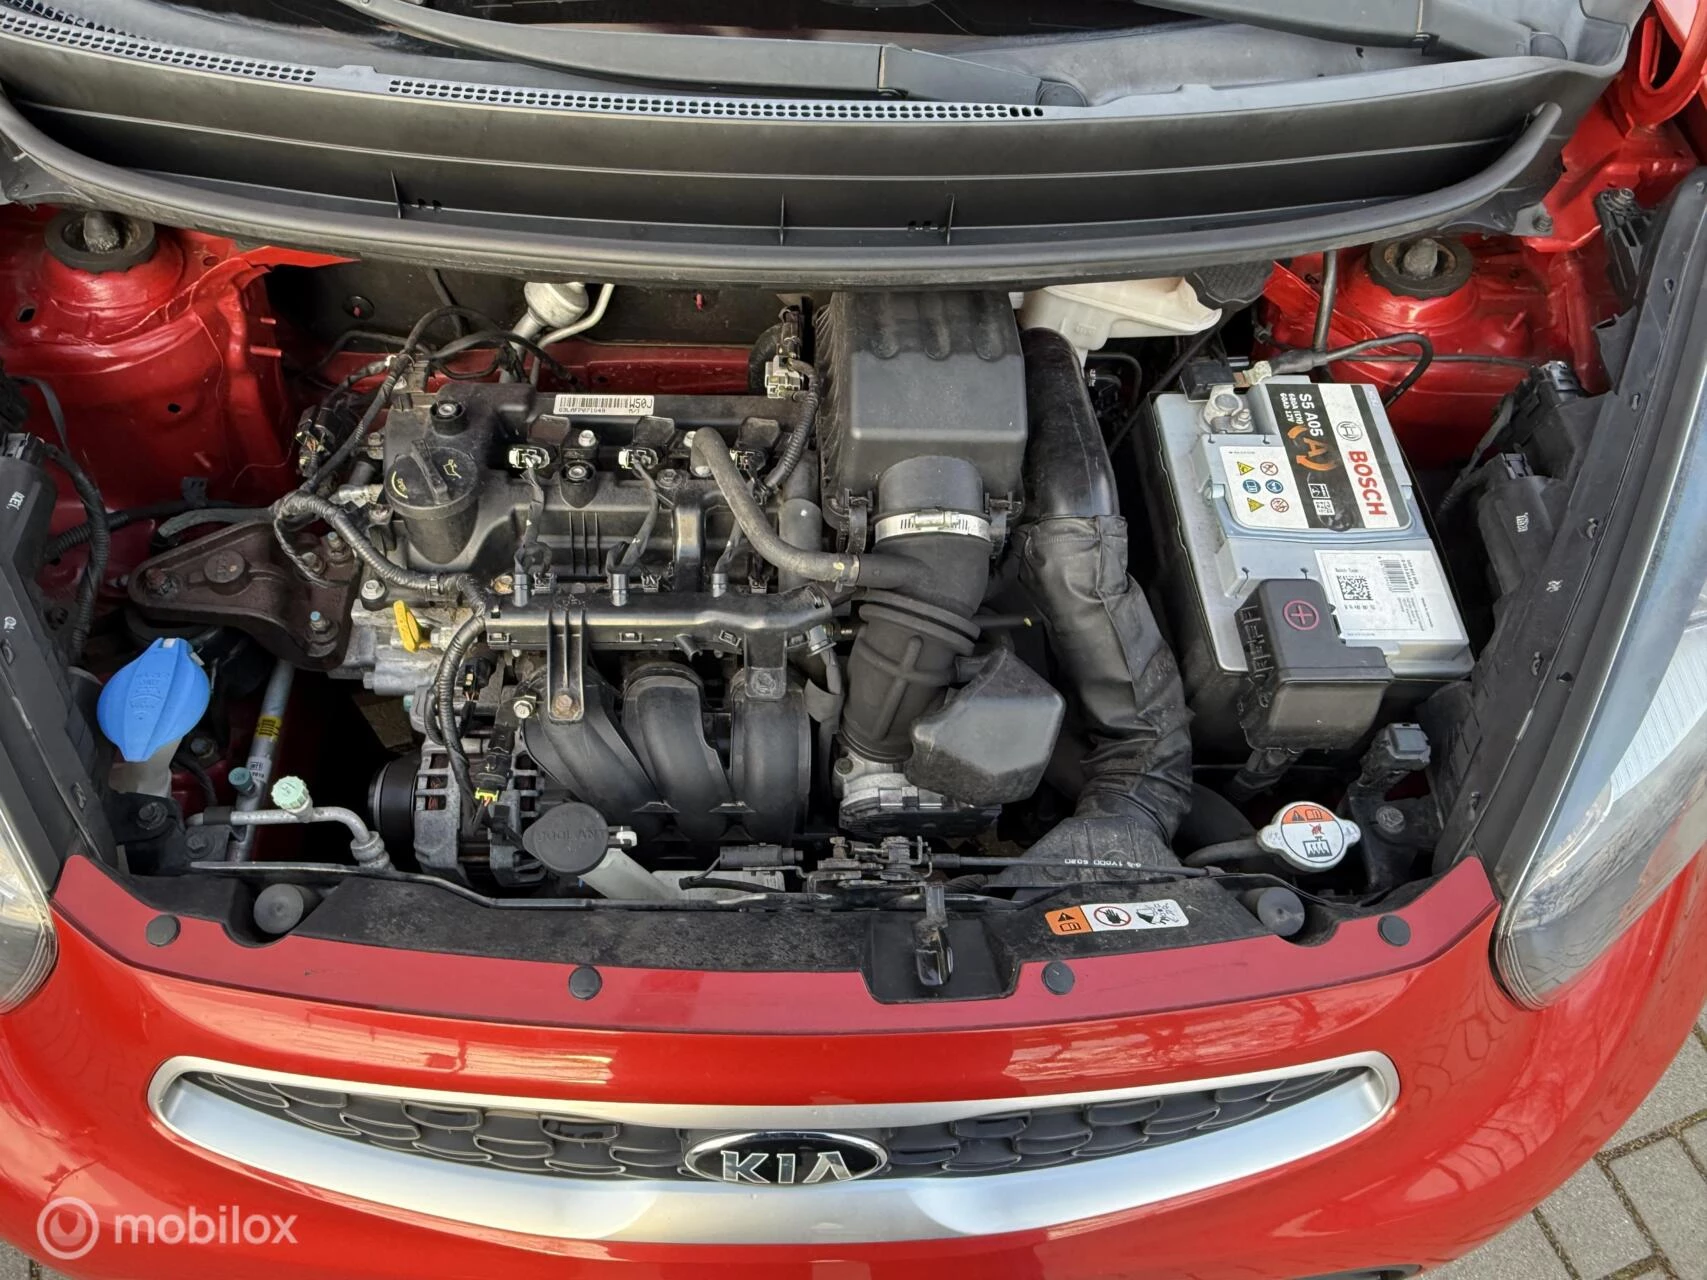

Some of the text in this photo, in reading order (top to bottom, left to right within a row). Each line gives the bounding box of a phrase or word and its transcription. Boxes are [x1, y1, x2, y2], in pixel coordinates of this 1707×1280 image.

[629, 398, 653, 409] W50J
[1299, 393, 1324, 437] S5 A05
[1348, 450, 1388, 515] BOSCH
[720, 1150, 853, 1184] KIA
